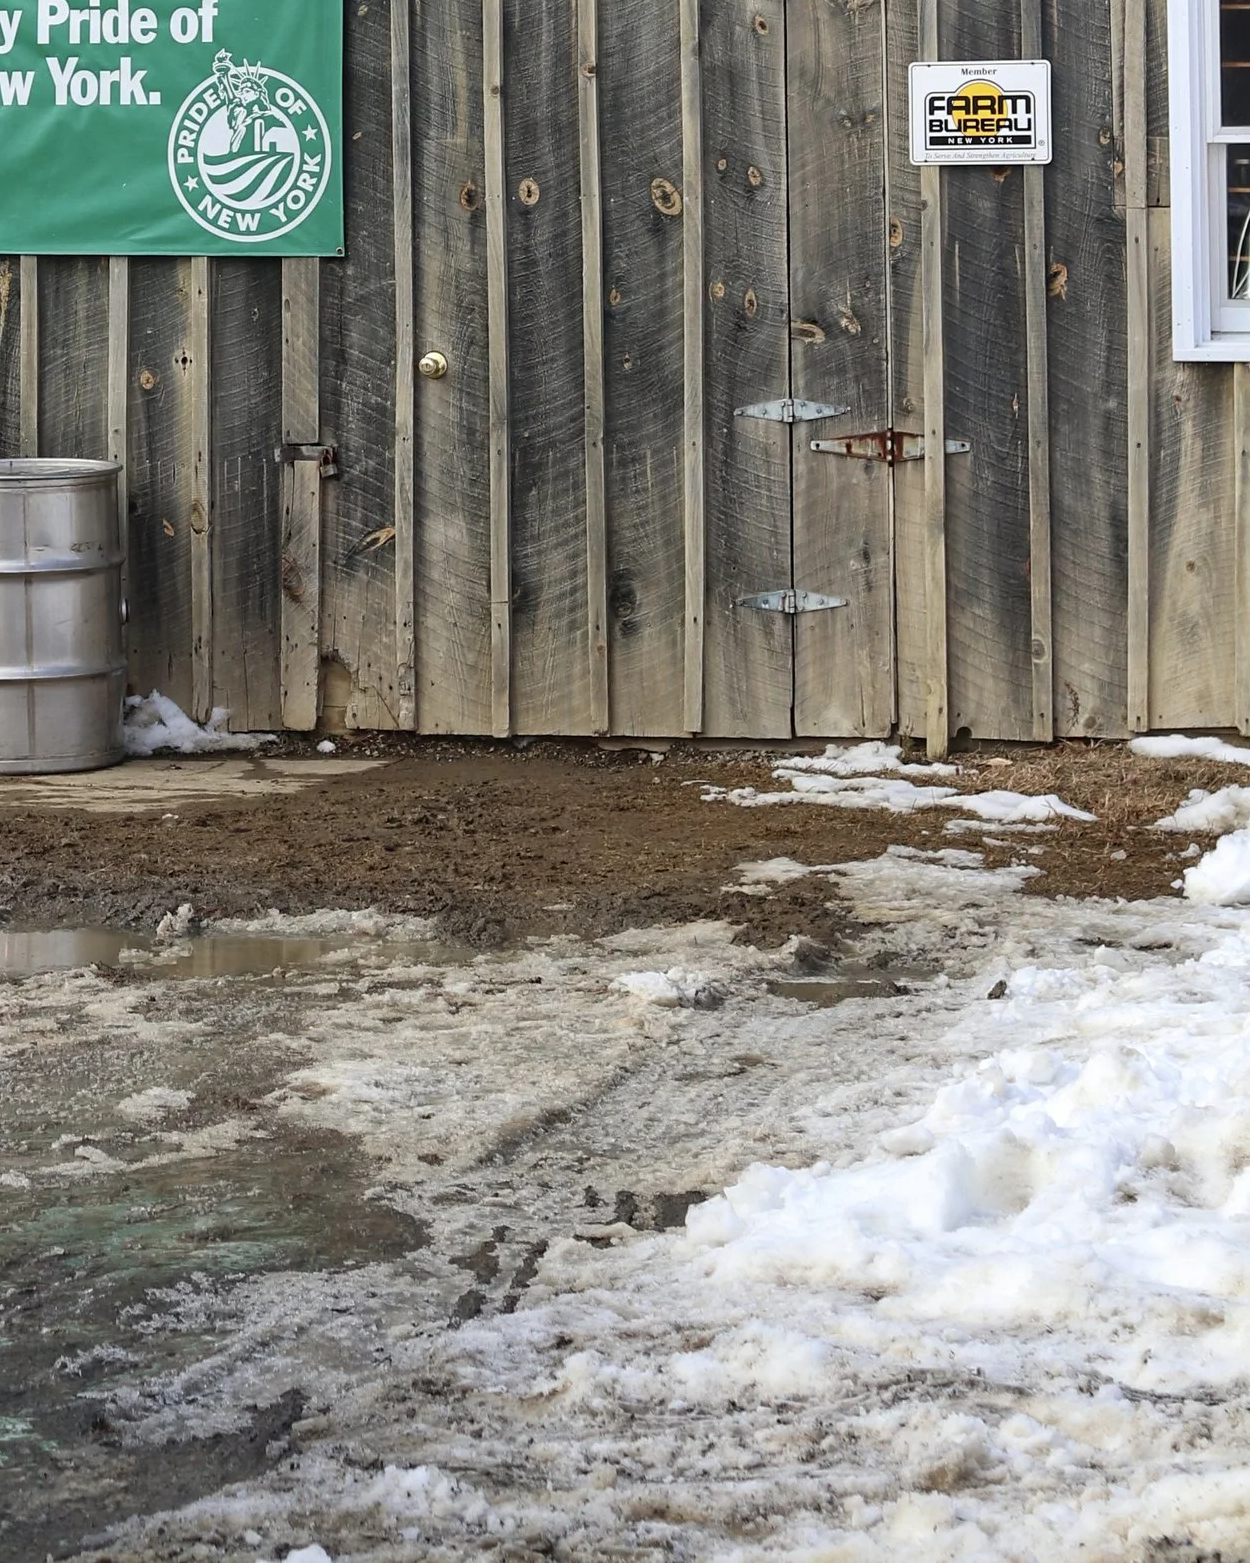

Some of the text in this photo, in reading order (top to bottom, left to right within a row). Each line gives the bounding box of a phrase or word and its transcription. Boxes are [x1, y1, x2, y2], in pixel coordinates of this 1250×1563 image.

[46, 56, 161, 106] York.
[961, 67, 997, 76] Member
[928, 94, 1032, 116] FARM
[177, 87, 307, 164] PRIDE OF
[928, 117, 1032, 133] BUREAU
[966, 151, 1000, 160] Strengthen
[197, 152, 322, 232] NEW YORK
